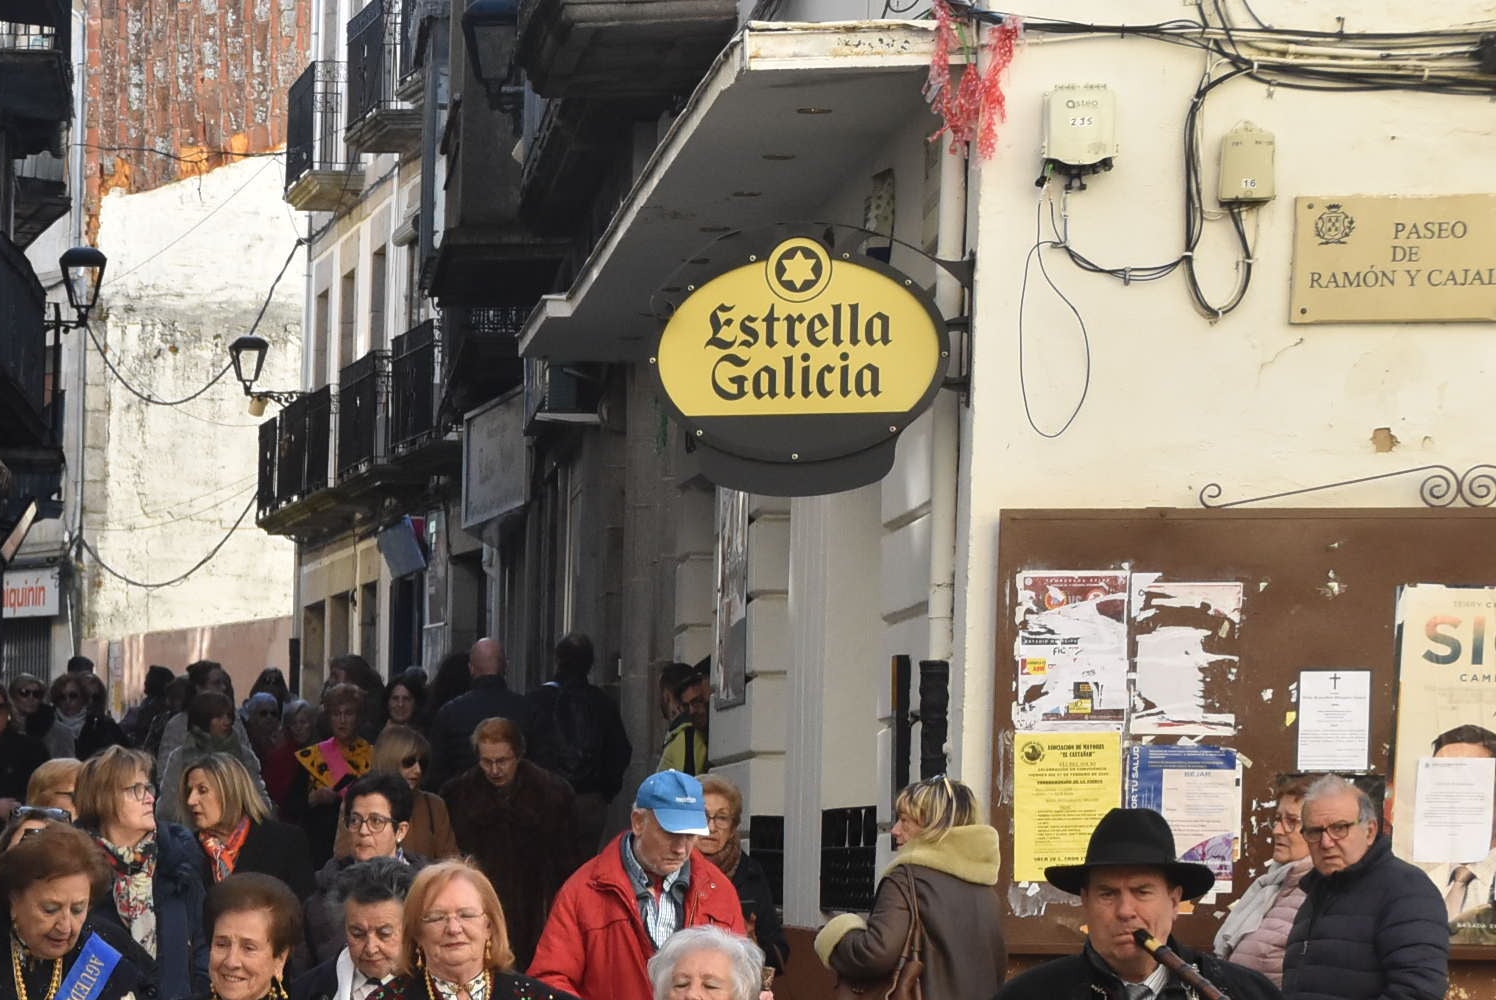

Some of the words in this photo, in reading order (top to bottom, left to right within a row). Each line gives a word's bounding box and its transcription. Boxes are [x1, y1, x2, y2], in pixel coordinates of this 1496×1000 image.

[1393, 220, 1468, 240] PASEO
[1391, 245, 1421, 263] DE
[1309, 265, 1397, 289] RAMÓN
[1404, 269, 1422, 287] Y
[1427, 268, 1496, 287] CAJAL
[704, 302, 893, 350] Estrella
[711, 351, 885, 401] Galicia
[2, 576, 46, 616] iquinín
[1422, 614, 1496, 666] SI
[1132, 746, 1140, 778] SALUD
[1131, 779, 1139, 793] TU
